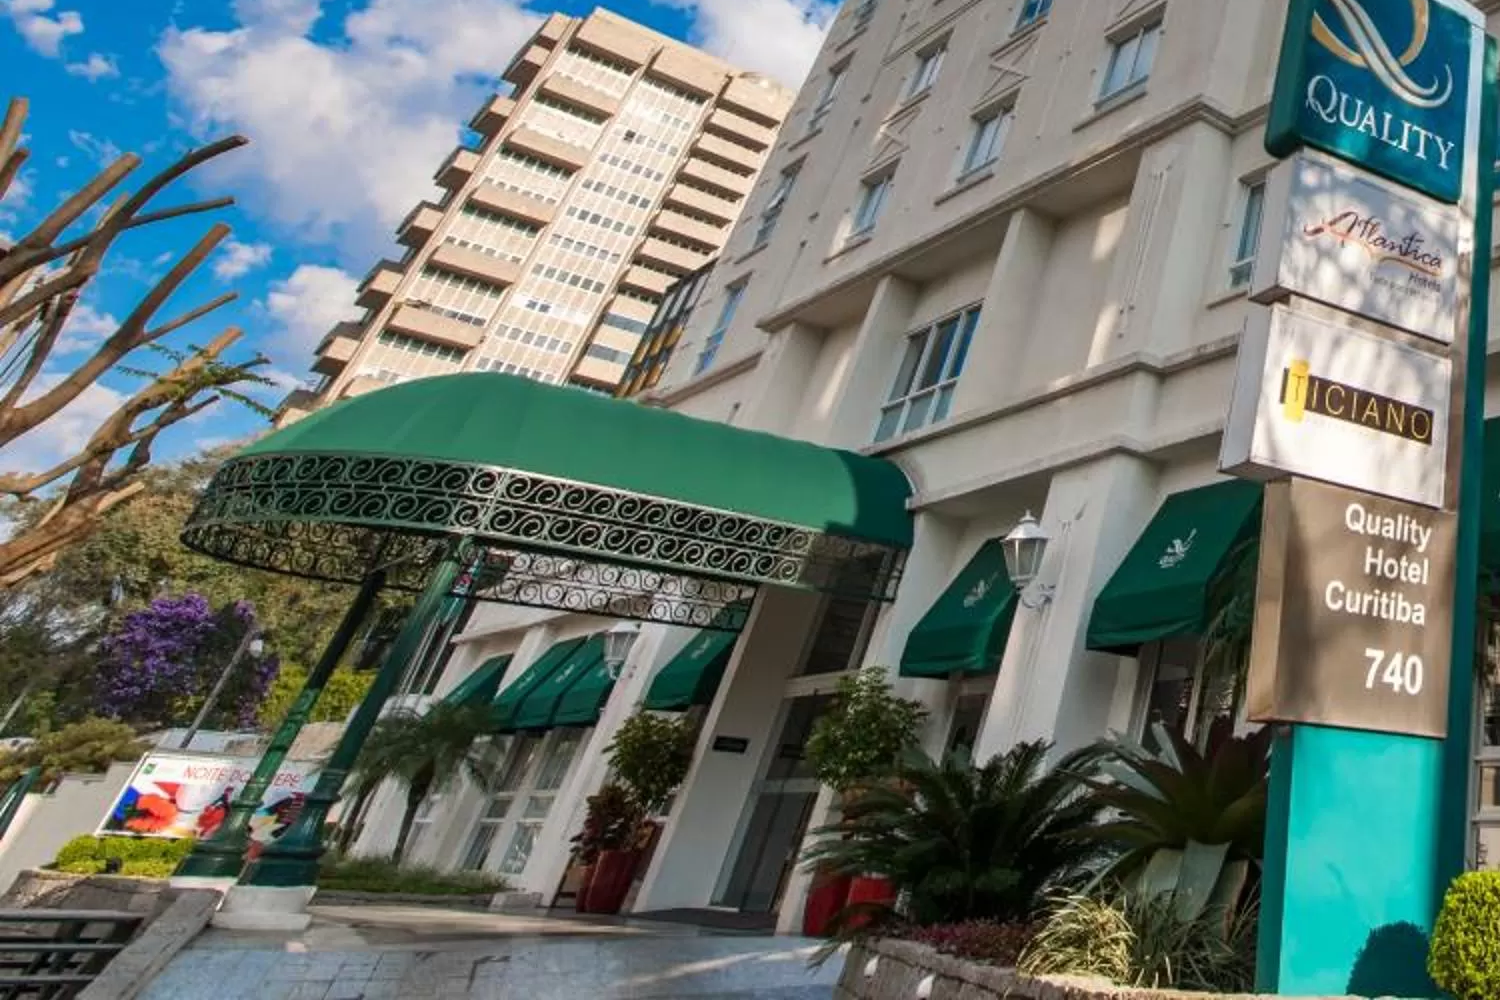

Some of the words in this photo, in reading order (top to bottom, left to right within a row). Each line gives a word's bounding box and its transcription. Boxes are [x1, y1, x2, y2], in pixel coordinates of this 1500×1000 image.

[1306, 74, 1455, 170] QUALITY
[1345, 503, 1432, 553] Quality
[1364, 546, 1429, 585] Hotel
[1325, 580, 1426, 625] Curitiba
[1364, 648, 1424, 696] 740
